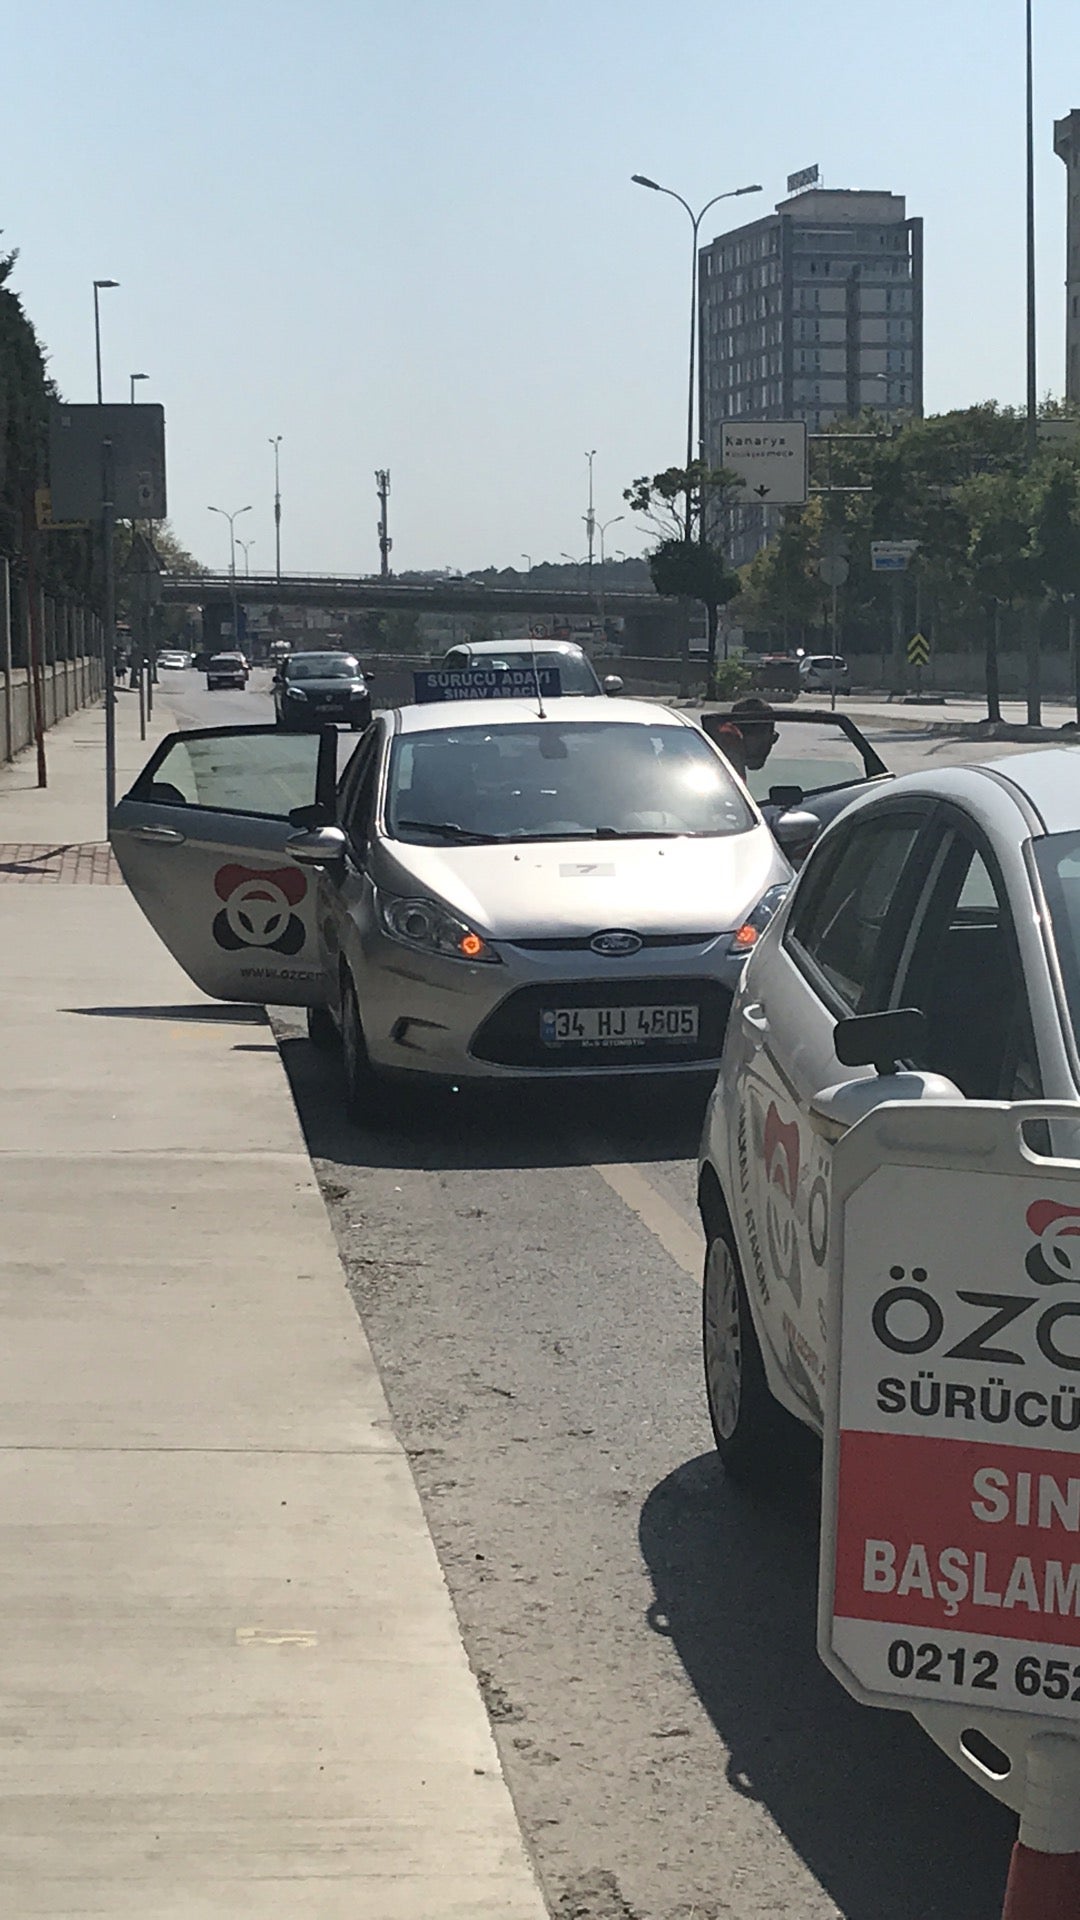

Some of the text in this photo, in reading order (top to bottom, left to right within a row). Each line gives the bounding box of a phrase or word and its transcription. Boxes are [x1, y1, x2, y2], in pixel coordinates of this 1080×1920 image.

[557, 1011, 584, 1036] 34
[876, 1371, 1080, 1431] SÜRÜCÜ
[971, 1467, 1080, 1532] SIN
[863, 1538, 1080, 1617] BAŞLAM
[888, 1639, 998, 1690] 0212
